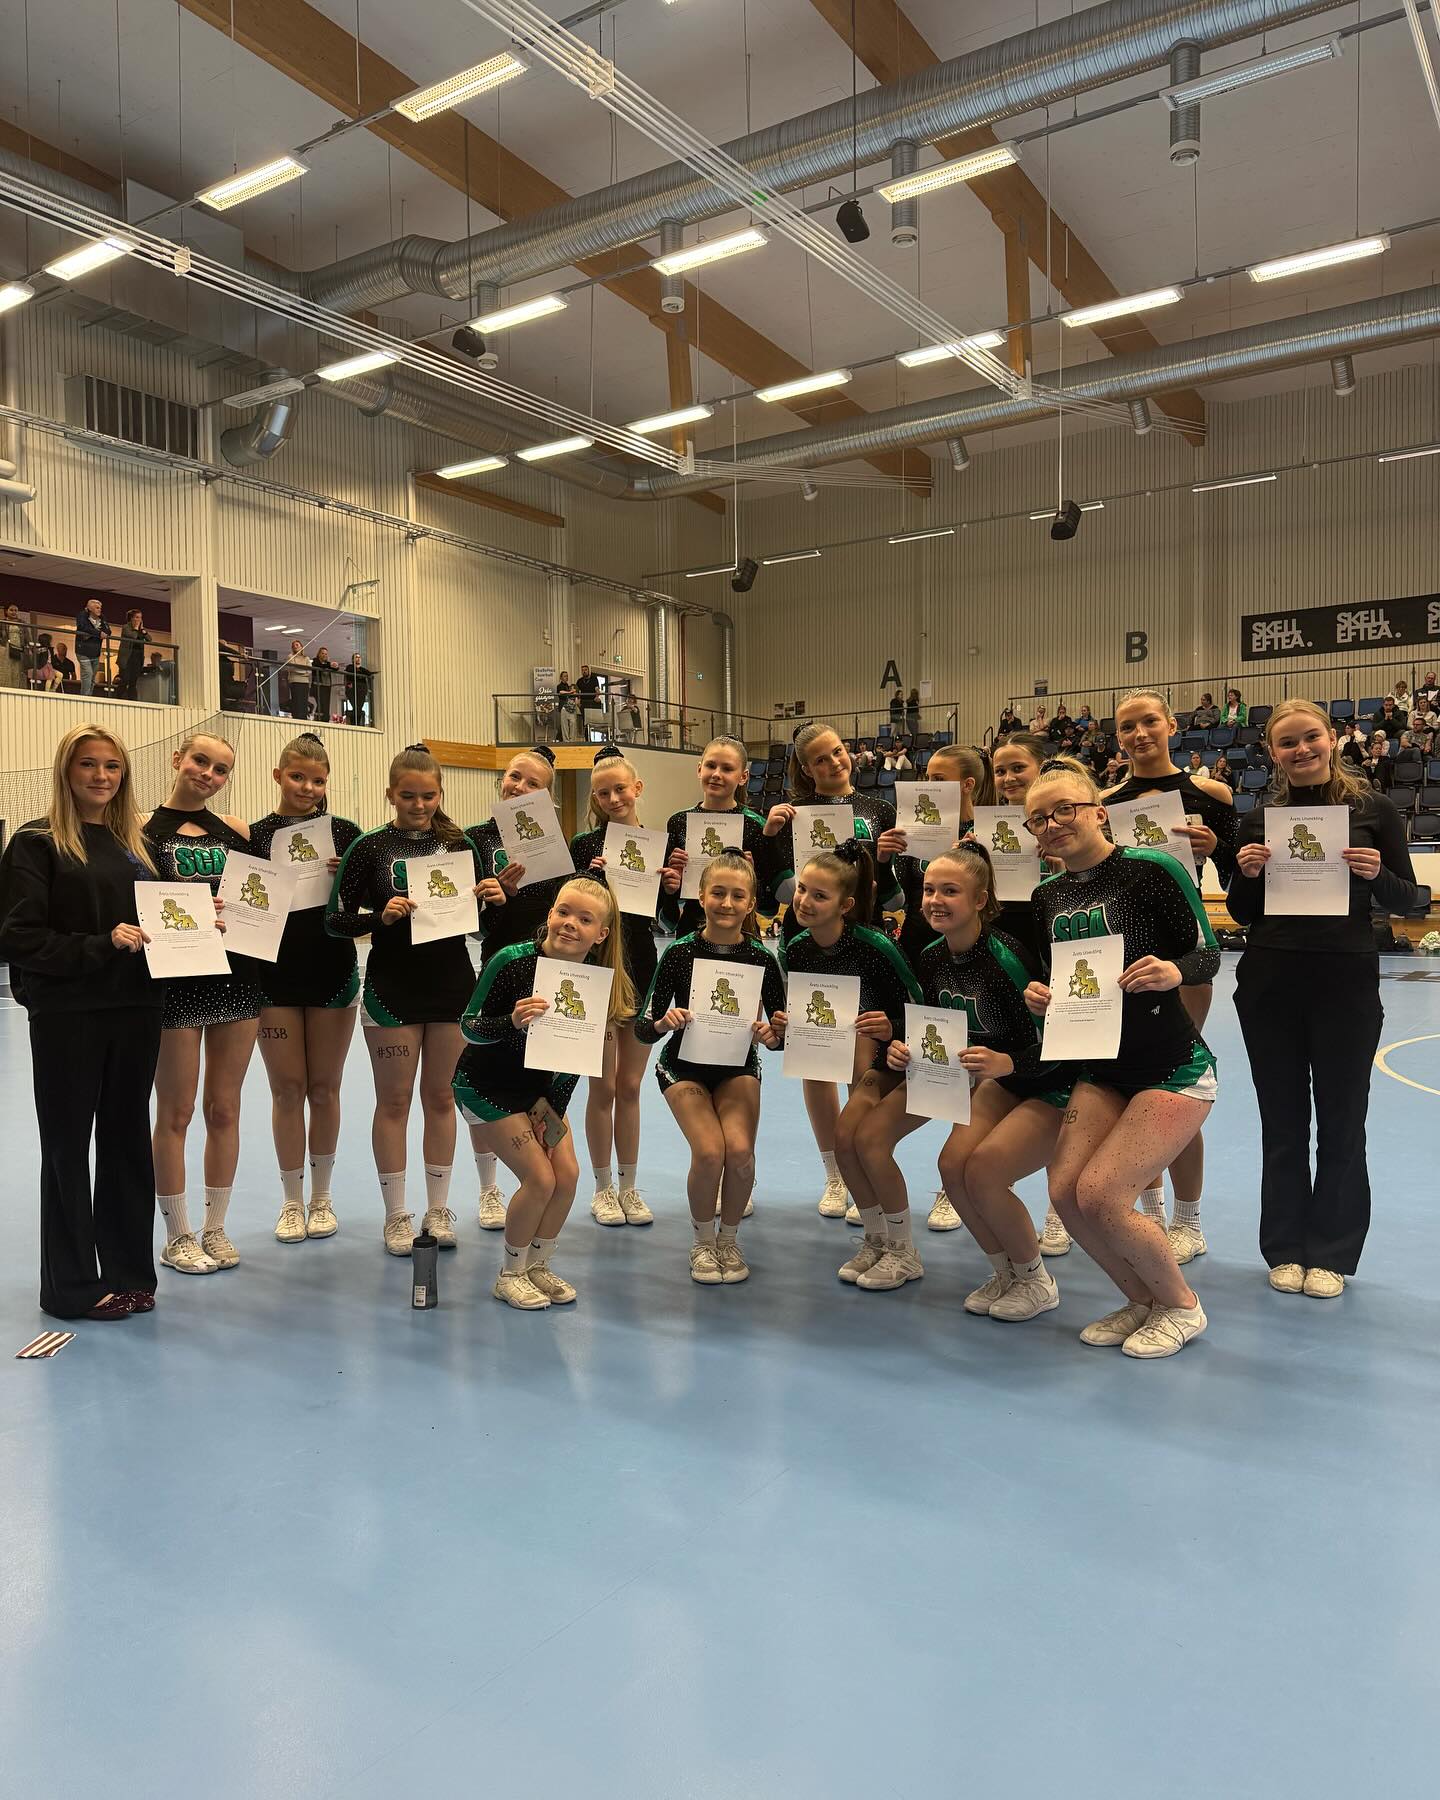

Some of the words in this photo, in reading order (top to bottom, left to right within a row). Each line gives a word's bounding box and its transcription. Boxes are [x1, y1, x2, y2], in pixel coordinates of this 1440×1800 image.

[1252, 618, 1302, 636] SKELL
[1336, 608, 1389, 627] SKELL
[1125, 631, 1148, 664] B
[880, 659, 902, 689] A
[1052, 903, 1113, 943] SCA
[377, 1045, 410, 1059] #STSB
